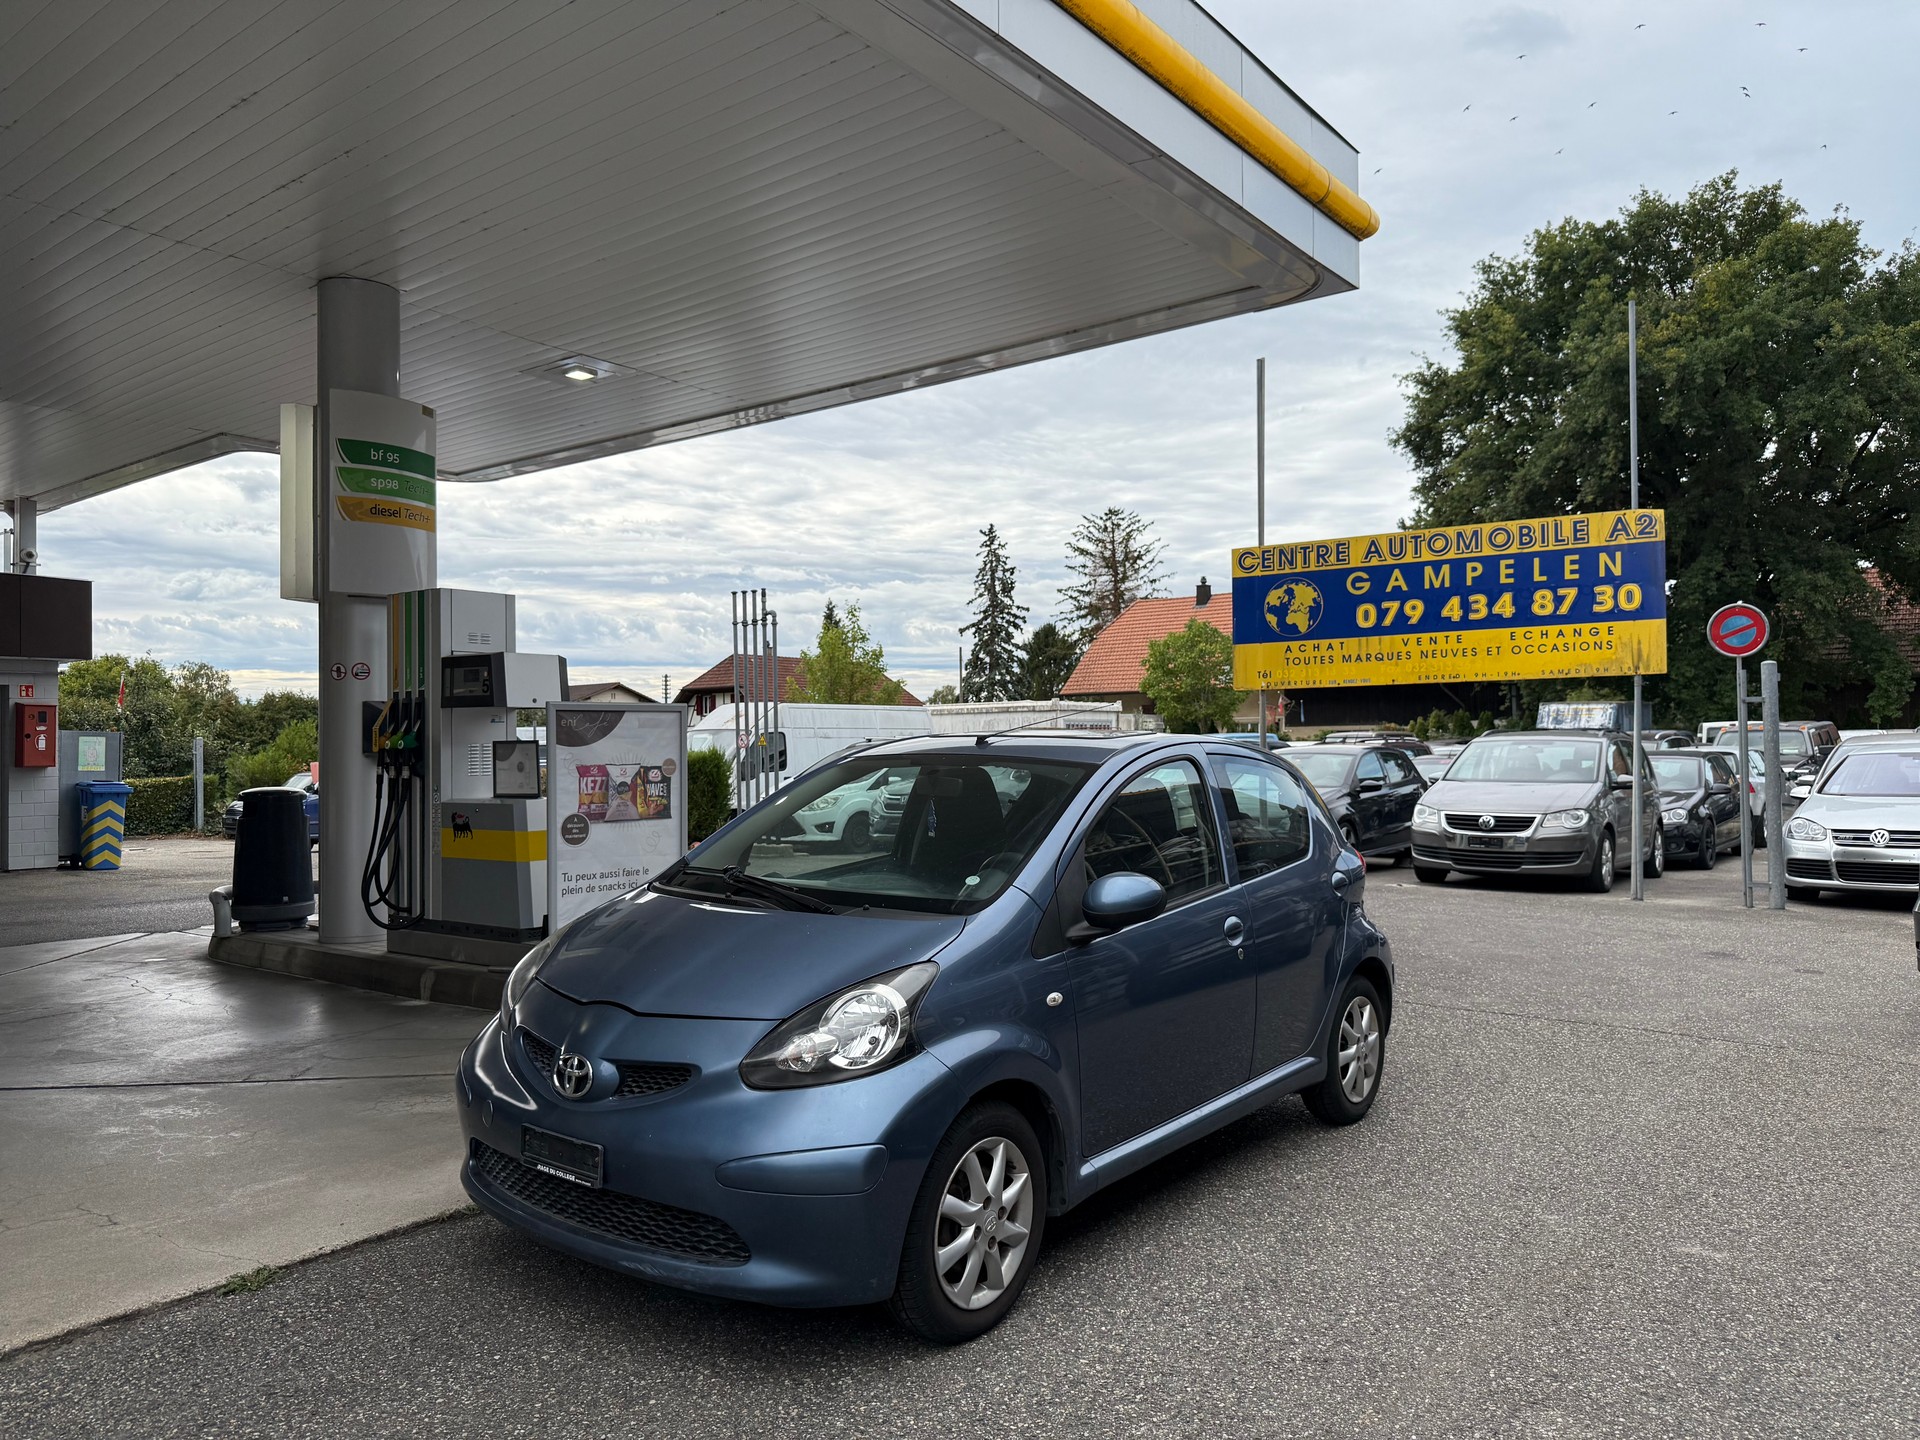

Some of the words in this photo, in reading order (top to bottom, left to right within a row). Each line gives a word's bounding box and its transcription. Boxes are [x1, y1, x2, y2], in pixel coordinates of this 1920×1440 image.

[371, 448, 384, 461] bf
[386, 452, 400, 464] 95
[370, 477, 399, 491] sp98
[370, 503, 402, 519] diesel
[404, 507, 431, 523] Tech+
[1237, 540, 1350, 574] CENTRE
[1360, 517, 1590, 564] AUTOMOBILE
[1605, 512, 1659, 543] A2
[1346, 551, 1622, 595] GAMPELEN
[1355, 598, 1425, 629] 079
[1440, 591, 1516, 622] 434
[1530, 586, 1579, 616] 87
[1592, 582, 1643, 613] 30
[1284, 641, 1346, 654] ACHAT
[1401, 634, 1463, 647] VENTE
[1509, 625, 1615, 641] ECHANGE
[1284, 654, 1335, 667] TOUTES
[1341, 651, 1412, 664] MARQUES
[1420, 646, 1478, 660] NEUVES
[1486, 645, 1502, 657] ET
[1510, 640, 1614, 656] OCCASIONS
[1256, 669, 1272, 680] Tél
[481, 678, 490, 694] 5
[561, 872, 573, 882] Tu
[575, 872, 598, 883] peux
[599, 867, 620, 880] aussi
[622, 866, 641, 877] faire
[642, 866, 650, 876] le
[561, 884, 583, 898] plein
[585, 883, 596, 893] de
[597, 881, 627, 892] snacks
[628, 879, 638, 889] ici
